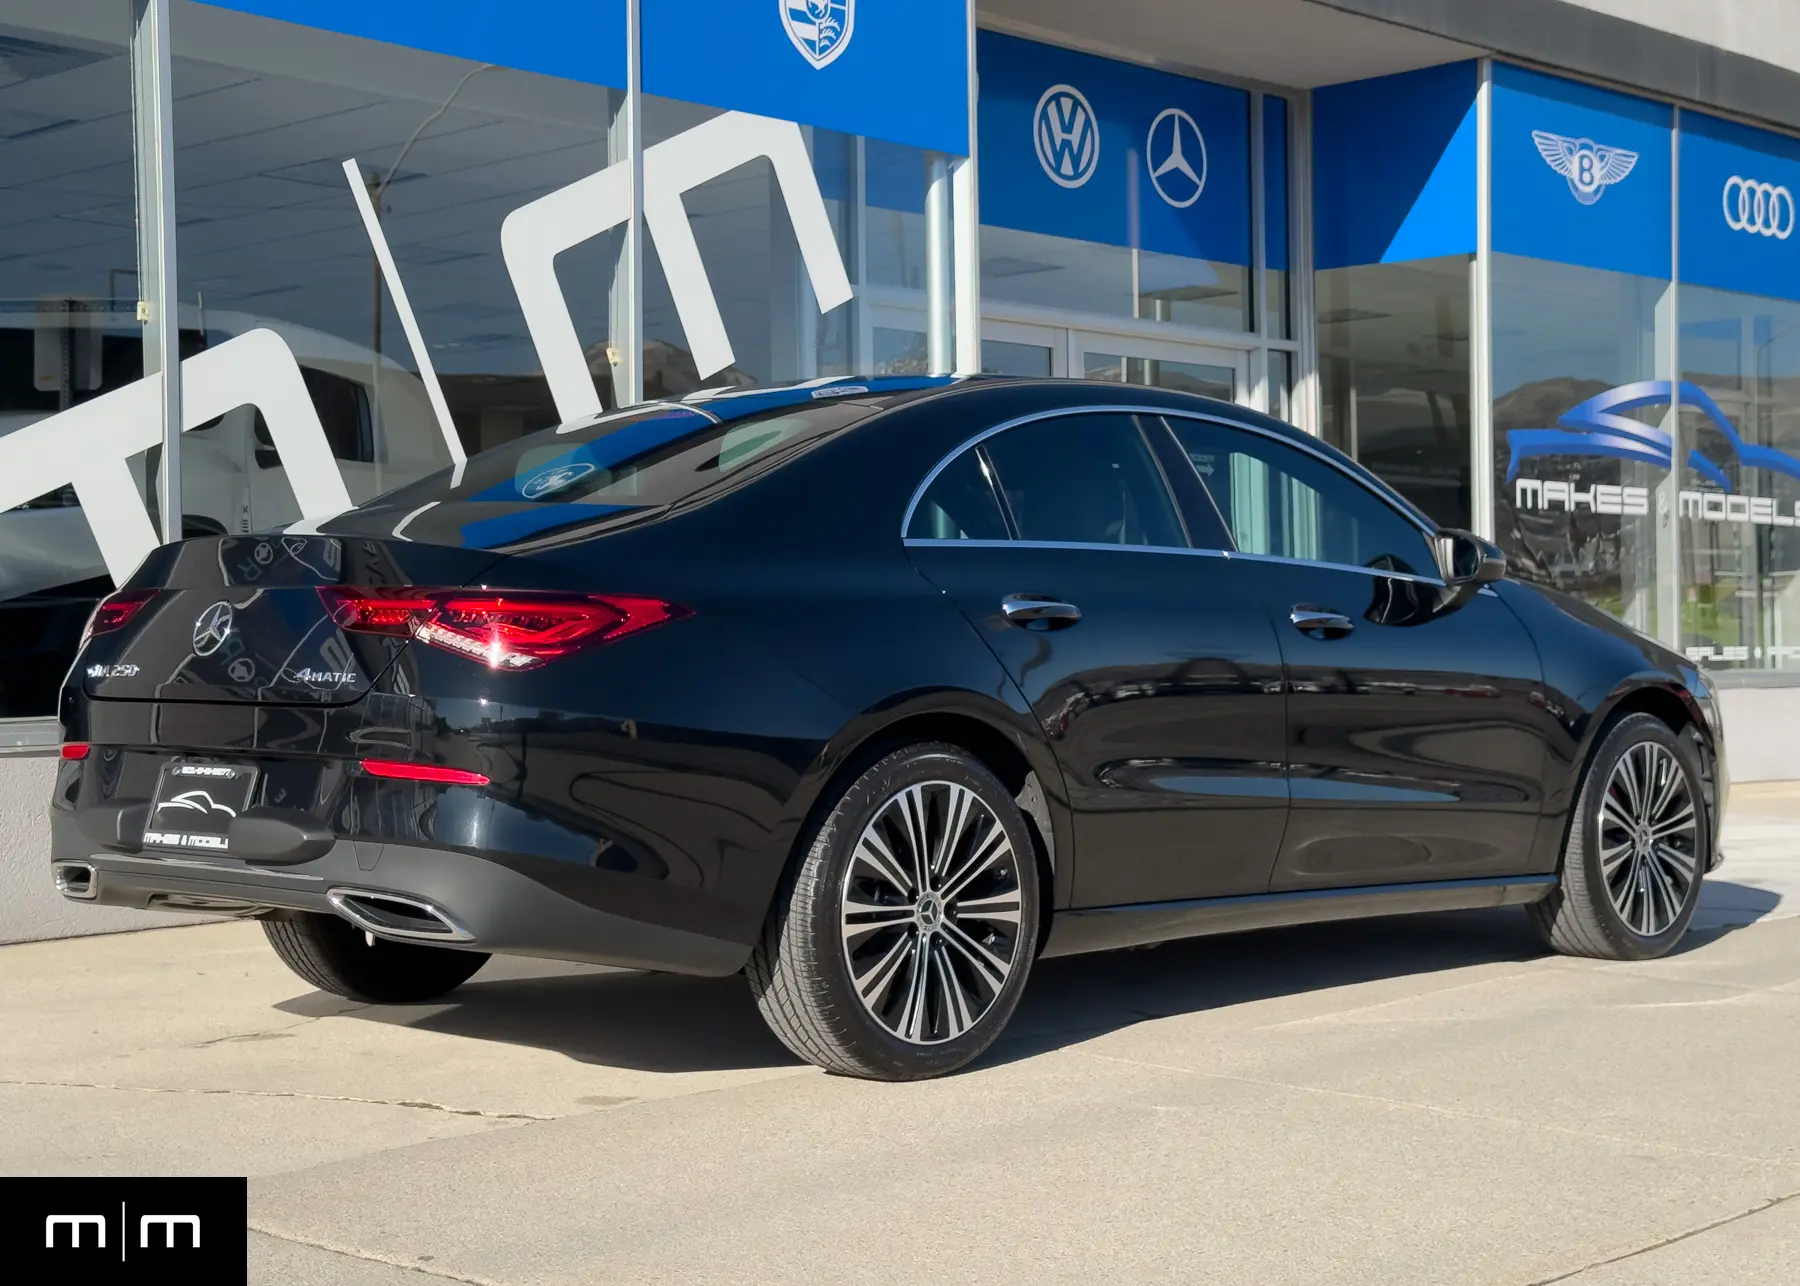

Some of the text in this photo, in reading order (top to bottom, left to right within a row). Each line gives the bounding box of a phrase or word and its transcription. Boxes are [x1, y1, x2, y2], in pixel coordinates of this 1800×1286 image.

[1516, 478, 1649, 516] MAKES
[1678, 490, 1800, 527] MODEL
[294, 667, 356, 682] 4MATIC
